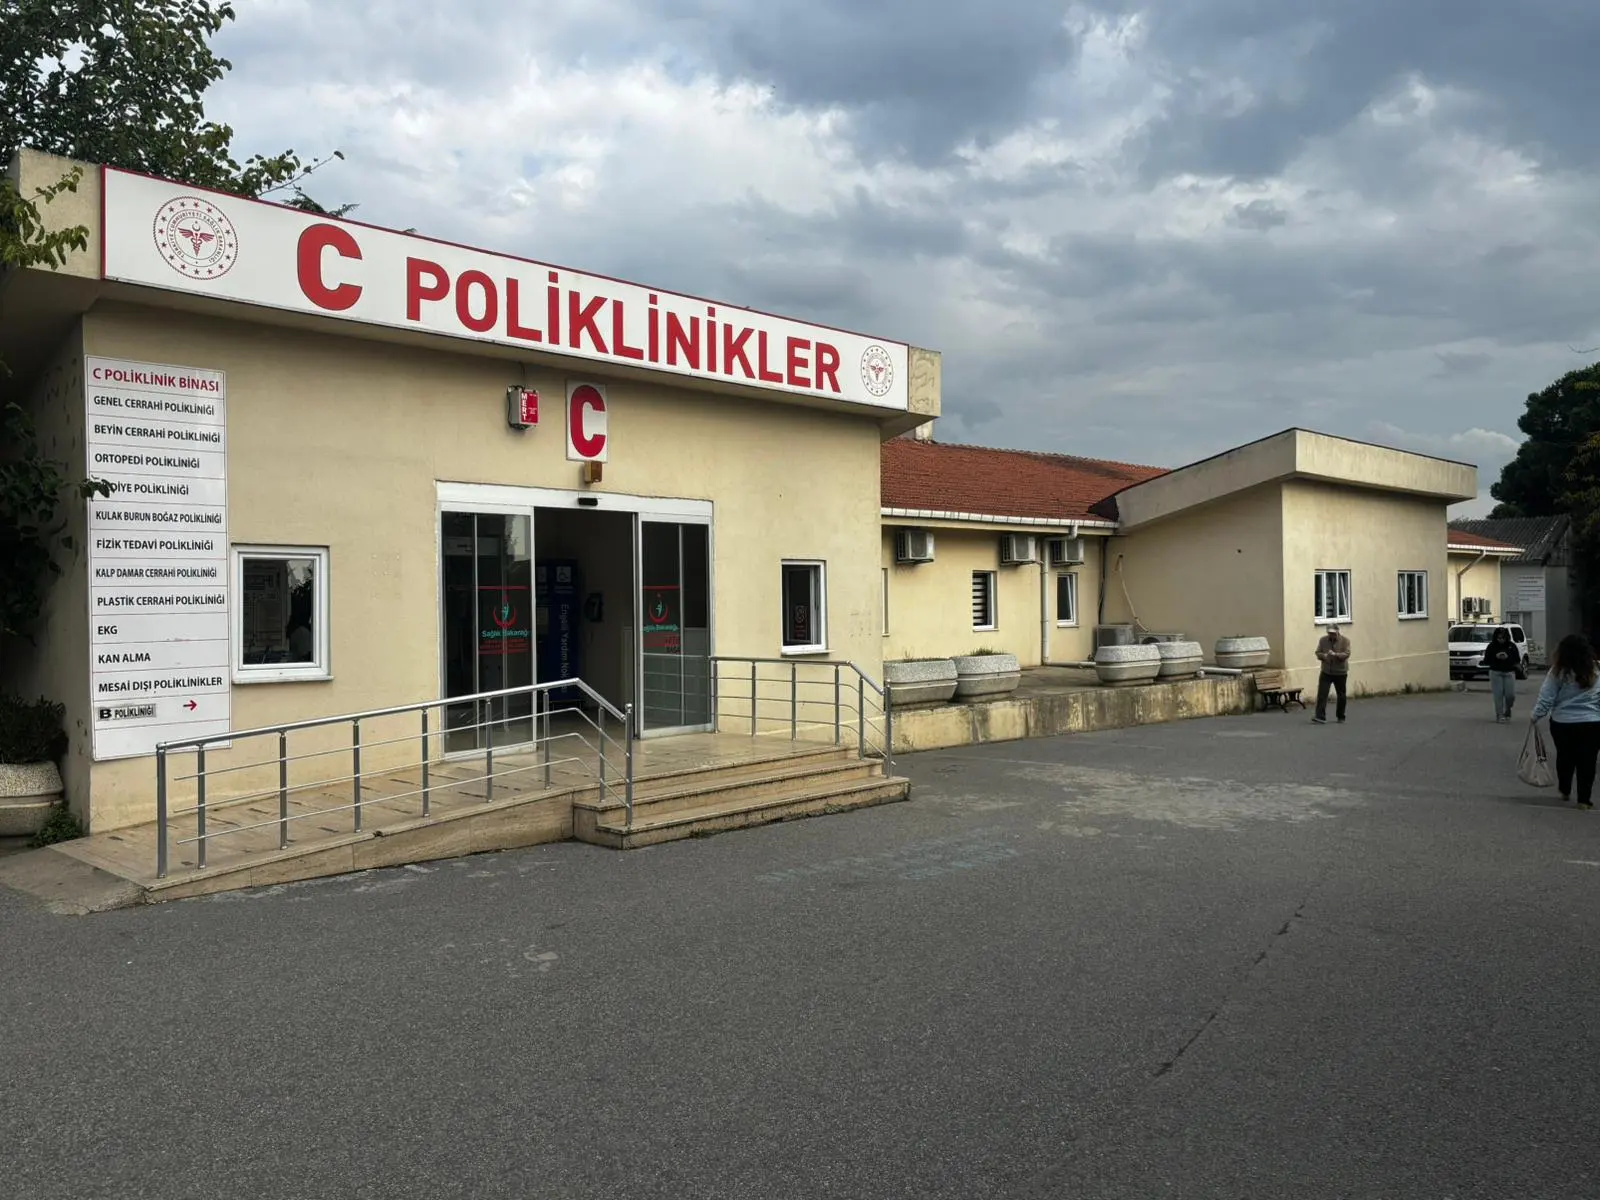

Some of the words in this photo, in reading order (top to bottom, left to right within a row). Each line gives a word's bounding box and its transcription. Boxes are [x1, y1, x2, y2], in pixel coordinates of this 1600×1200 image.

[296, 223, 363, 311] C
[406, 256, 841, 394] POLİKLİNİKLER
[93, 368, 102, 380] C
[105, 369, 176, 387] POLİKLİNİK
[179, 376, 219, 392] BİNASI
[94, 395, 123, 408] GENEL
[125, 397, 163, 411] CERRAHİ
[164, 402, 215, 416] POLİKLİNİĞİ
[570, 384, 607, 458] C
[94, 423, 123, 436] BEYİN
[125, 426, 166, 439] CERRAHİ
[167, 430, 221, 443] POLİKLİNİĞİ
[95, 453, 144, 466] ORTOPEDİ
[146, 455, 200, 469] POLİKLİNİĞİ
[134, 482, 189, 495] POLİKLİNİĞİ
[95, 510, 123, 521] KULAK
[124, 511, 151, 521] BURUN
[152, 511, 178, 522] BOĞAZ
[179, 511, 222, 524] POLİKLİNİĞİ
[96, 538, 121, 549] FİZİK
[123, 539, 157, 550] TEDAVİ
[159, 538, 214, 551] POLİKLİNİĞİ
[96, 568, 116, 578] KALP
[116, 568, 144, 578] DAMAR
[145, 567, 176, 578] CERRAHİ
[177, 567, 217, 578] POLİKLİNİĞİ
[97, 594, 135, 606] PLASTİK
[136, 594, 174, 606] CERRAHİ
[175, 592, 225, 605] POLİKLİNİĞİ
[97, 625, 118, 635] EKG
[98, 653, 120, 664] KAN
[122, 652, 151, 663] ALMA
[98, 680, 131, 693] MESAİ
[132, 680, 152, 693] DIŞI
[154, 676, 223, 690] POLİKLİNİKLER
[99, 709, 113, 719] B
[114, 706, 154, 718] POLİKLİNİĞİ
